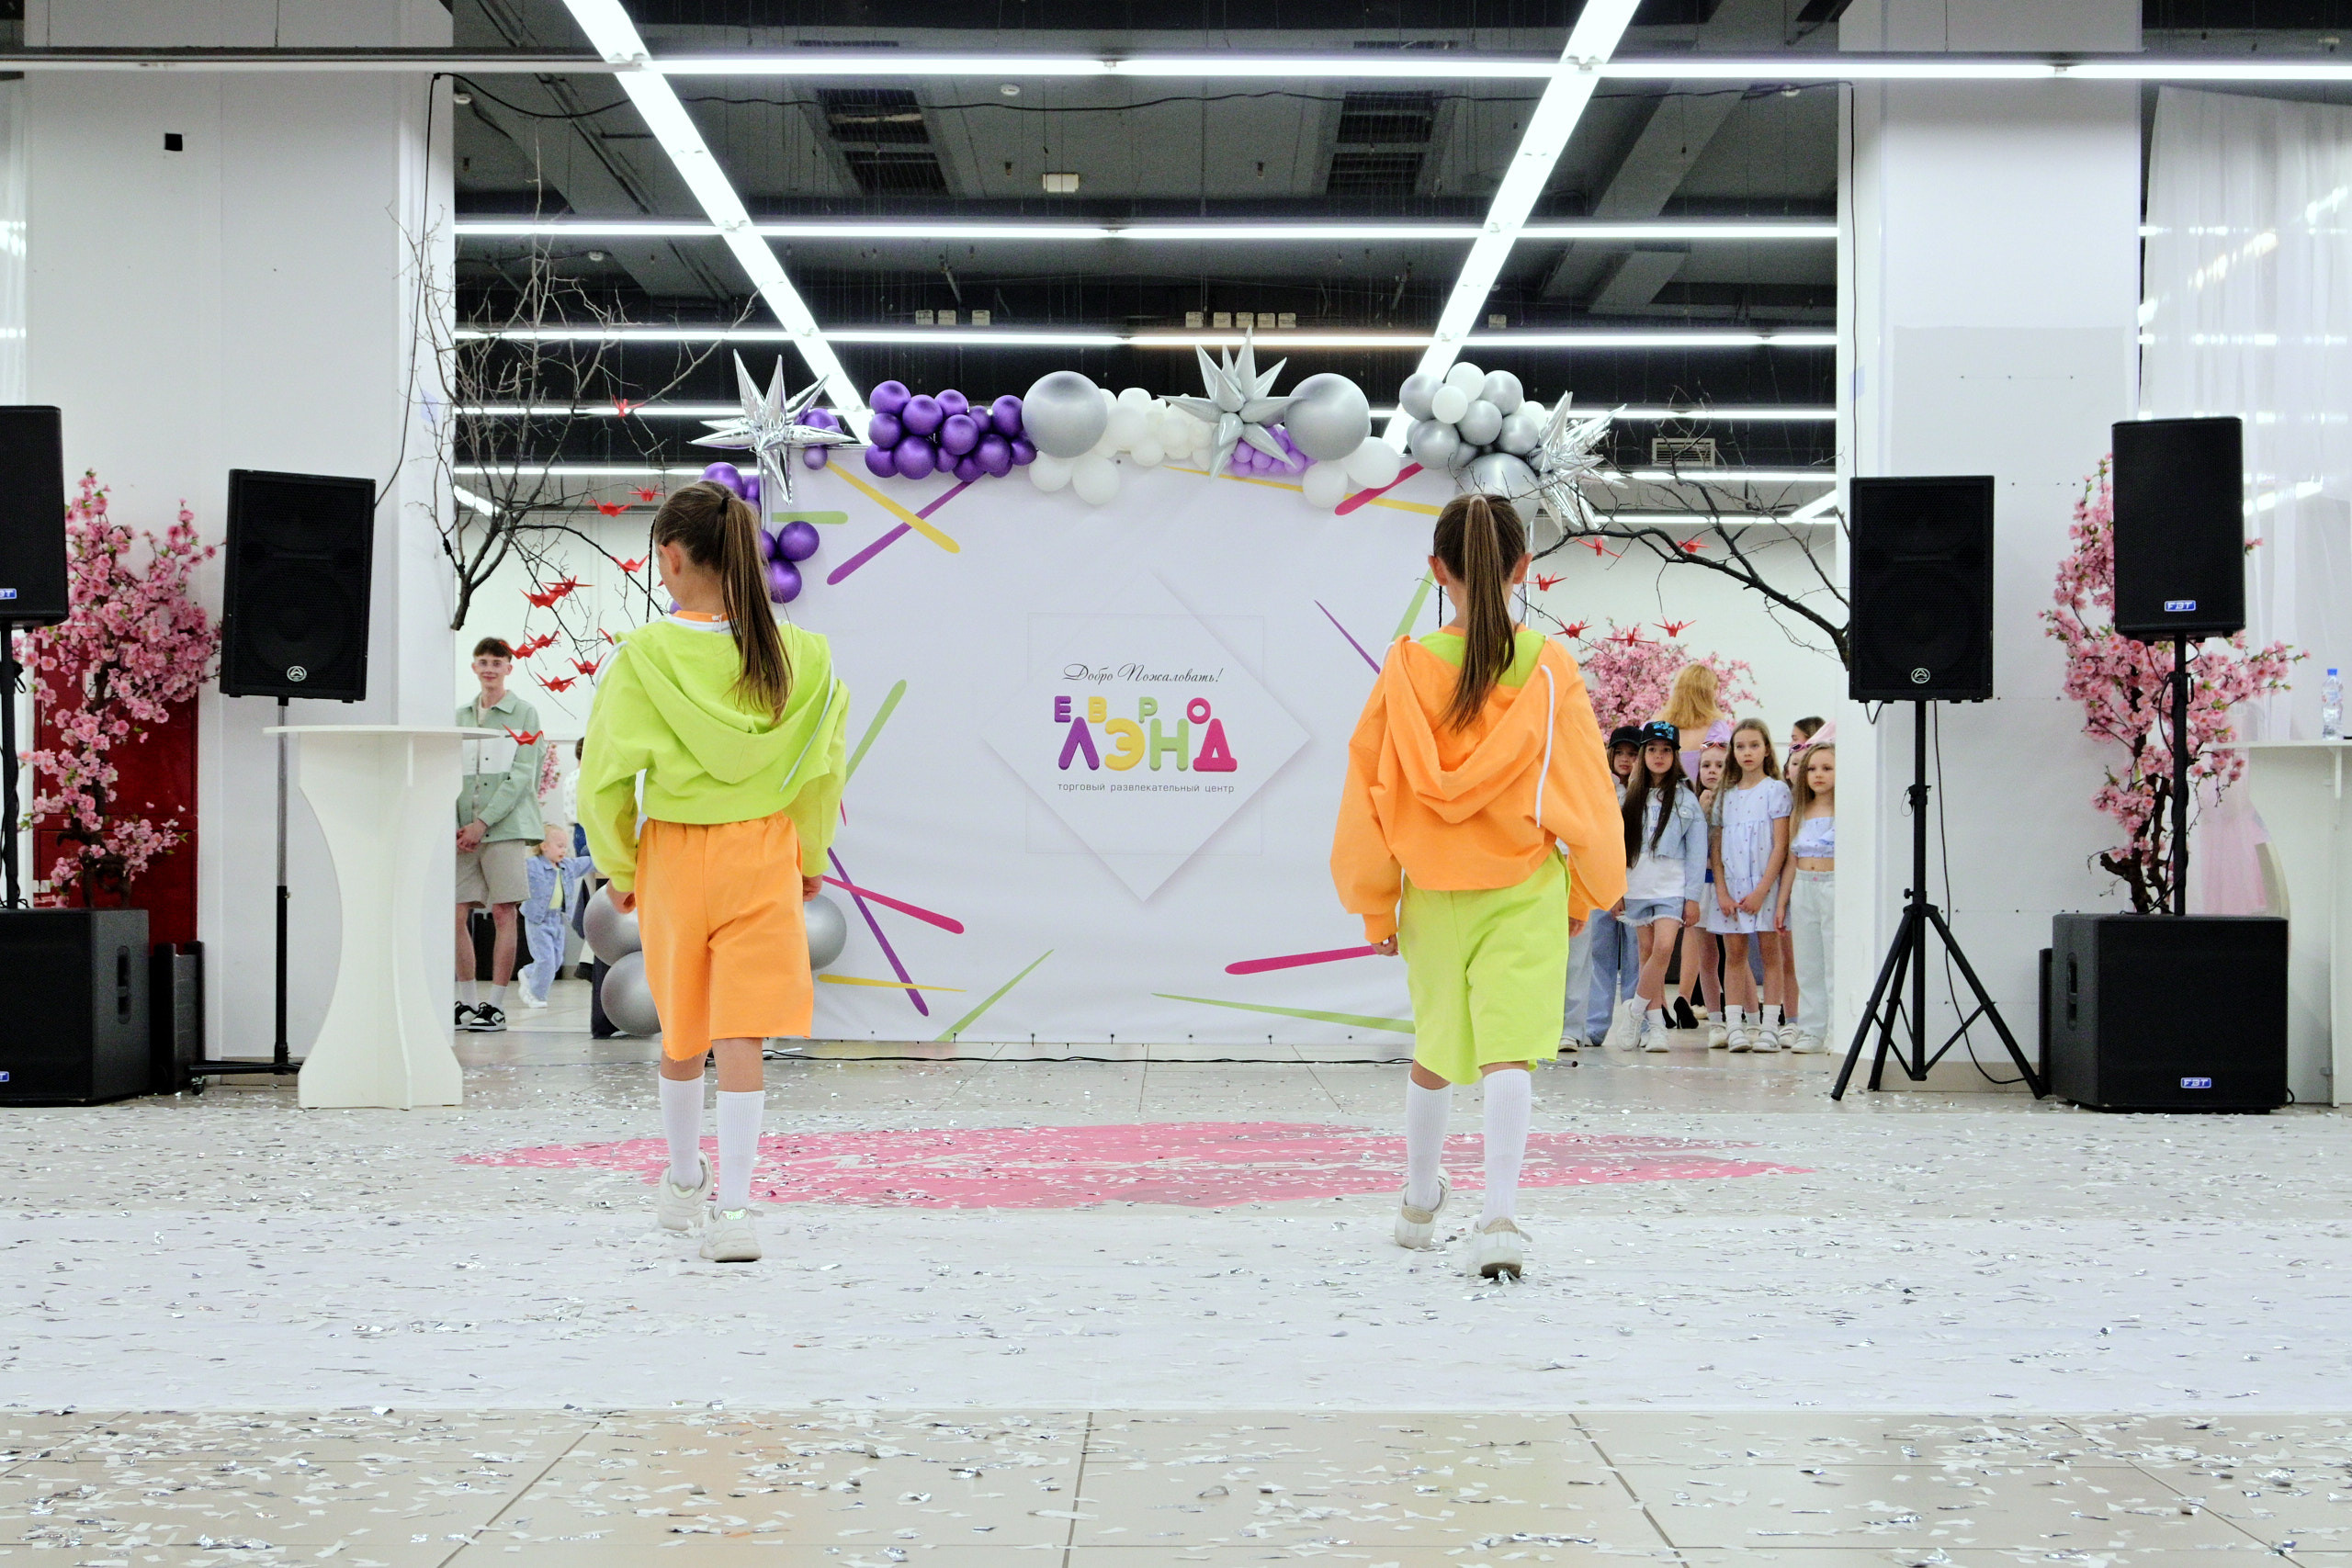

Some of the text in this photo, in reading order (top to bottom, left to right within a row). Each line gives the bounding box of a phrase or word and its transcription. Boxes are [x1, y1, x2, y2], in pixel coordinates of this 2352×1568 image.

[1062, 662, 1224, 685] Добро Пожаловать!
[1054, 695, 1211, 724] ЕВРО
[1058, 716, 1238, 772] ЛЭНД
[1057, 783, 1235, 794] торговый развлекательный центр
[2183, 1078, 2209, 1087] FBT
